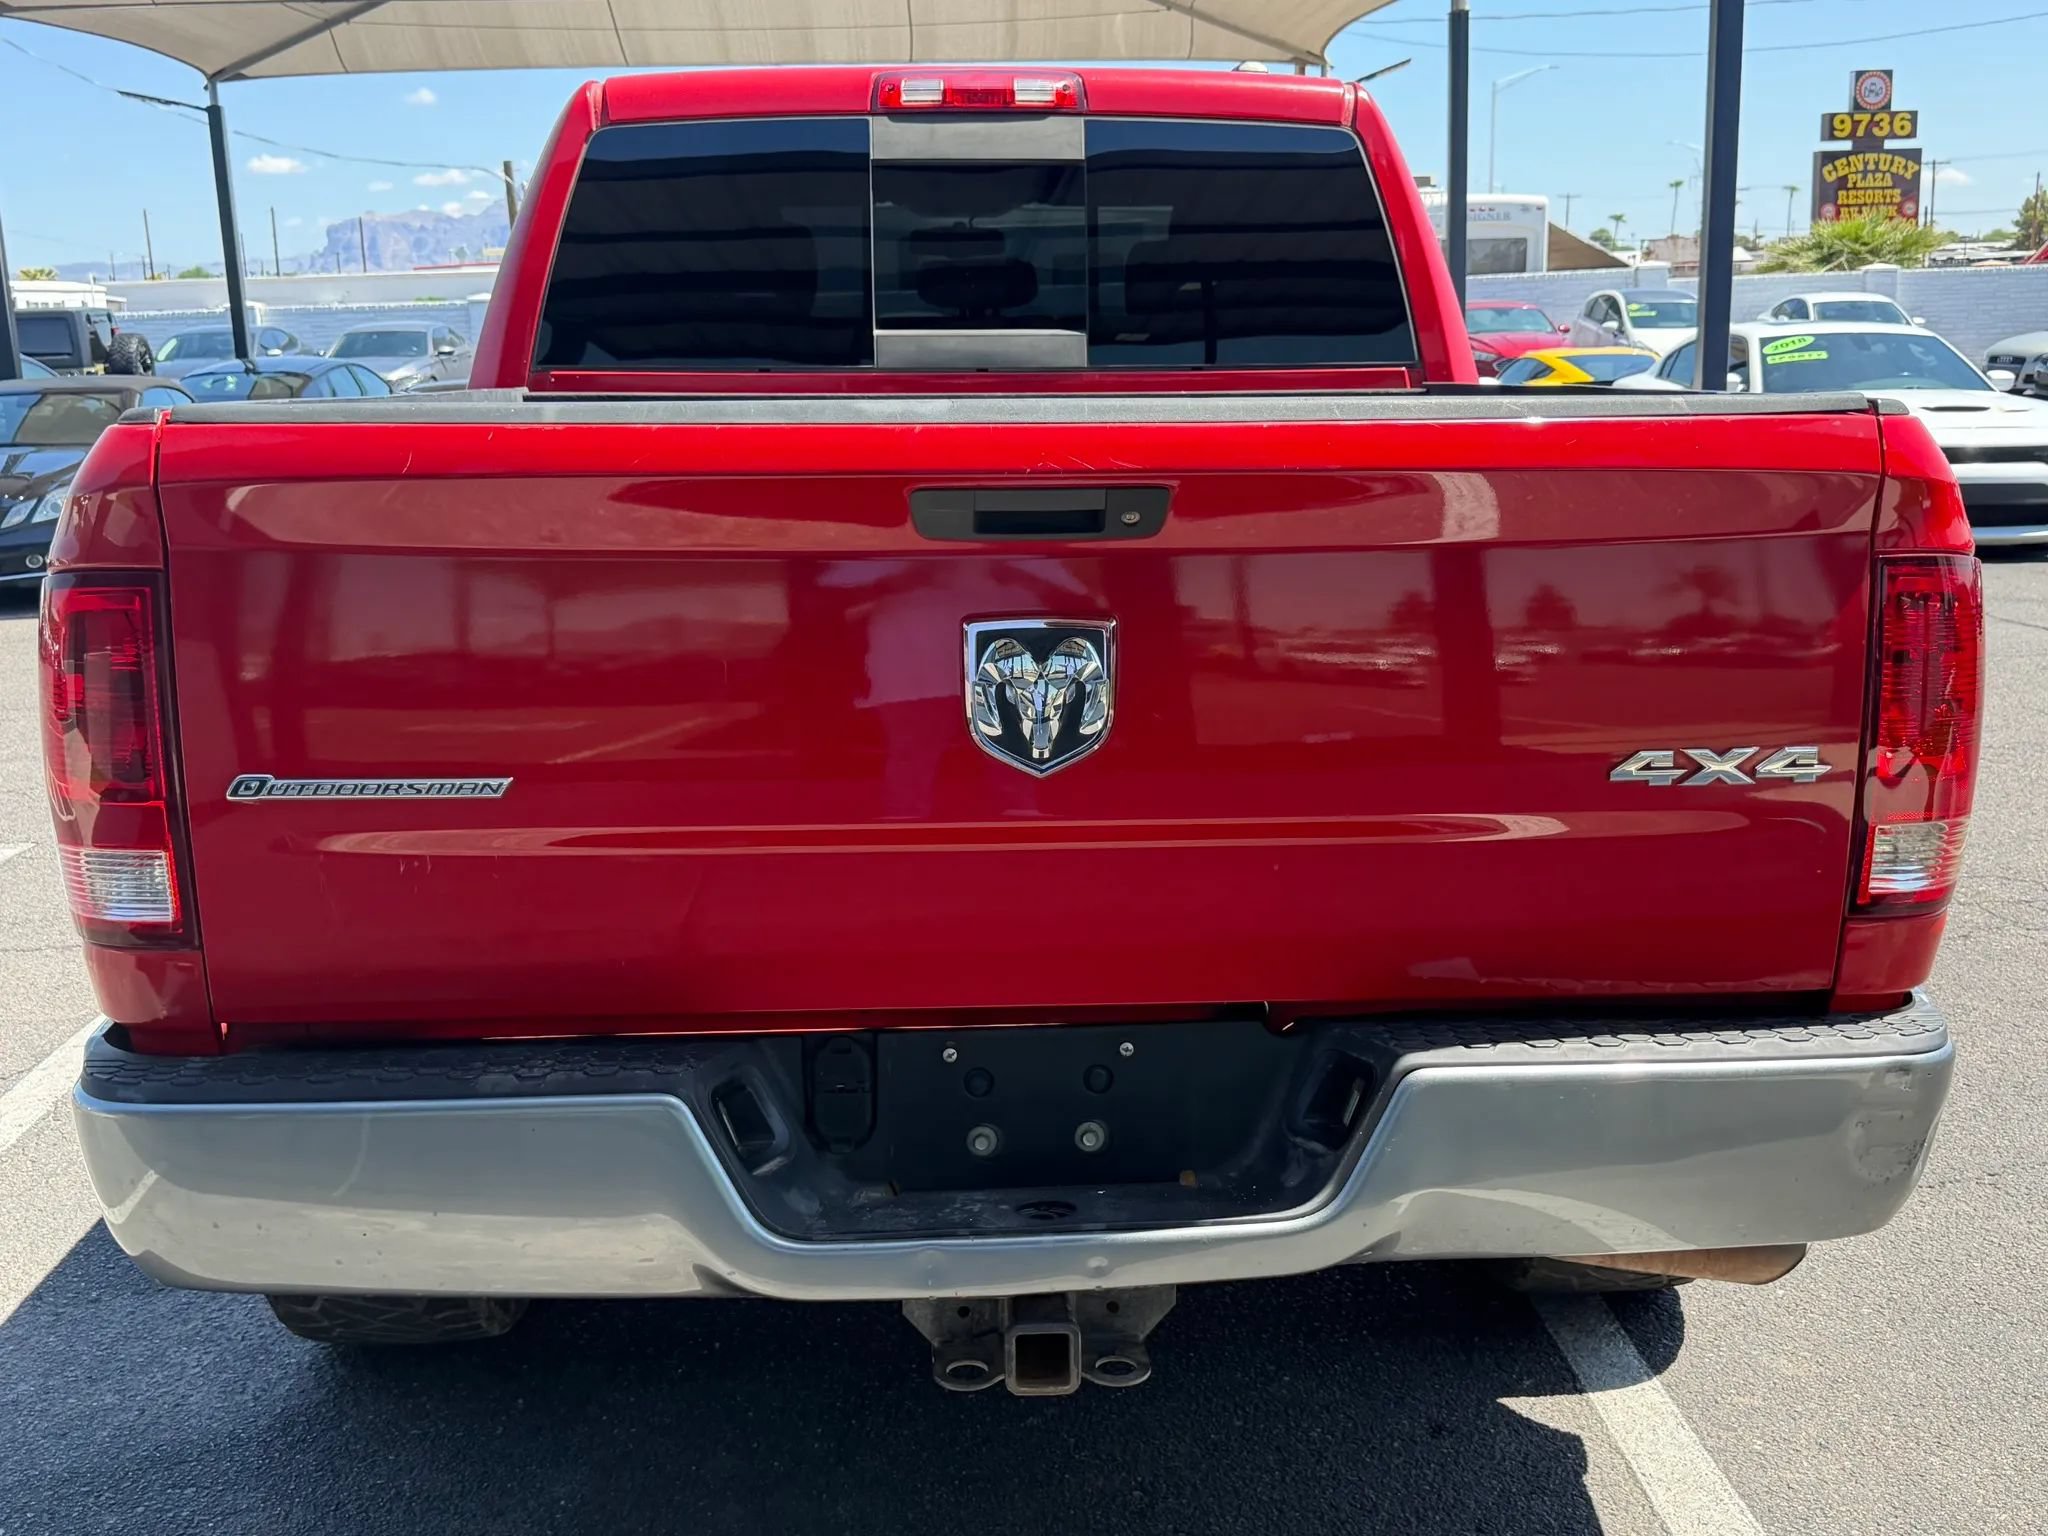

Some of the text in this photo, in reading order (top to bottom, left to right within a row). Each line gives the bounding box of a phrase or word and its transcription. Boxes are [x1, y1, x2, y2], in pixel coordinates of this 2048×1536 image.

[1833, 112, 1911, 138] 9736
[1822, 153, 1919, 183] CENTURY
[1847, 172, 1893, 188] PLAZA
[1837, 188, 1901, 205] RESORTS
[1610, 746, 1832, 785] 4X4
[227, 774, 512, 800] OUTDOORSMAN
